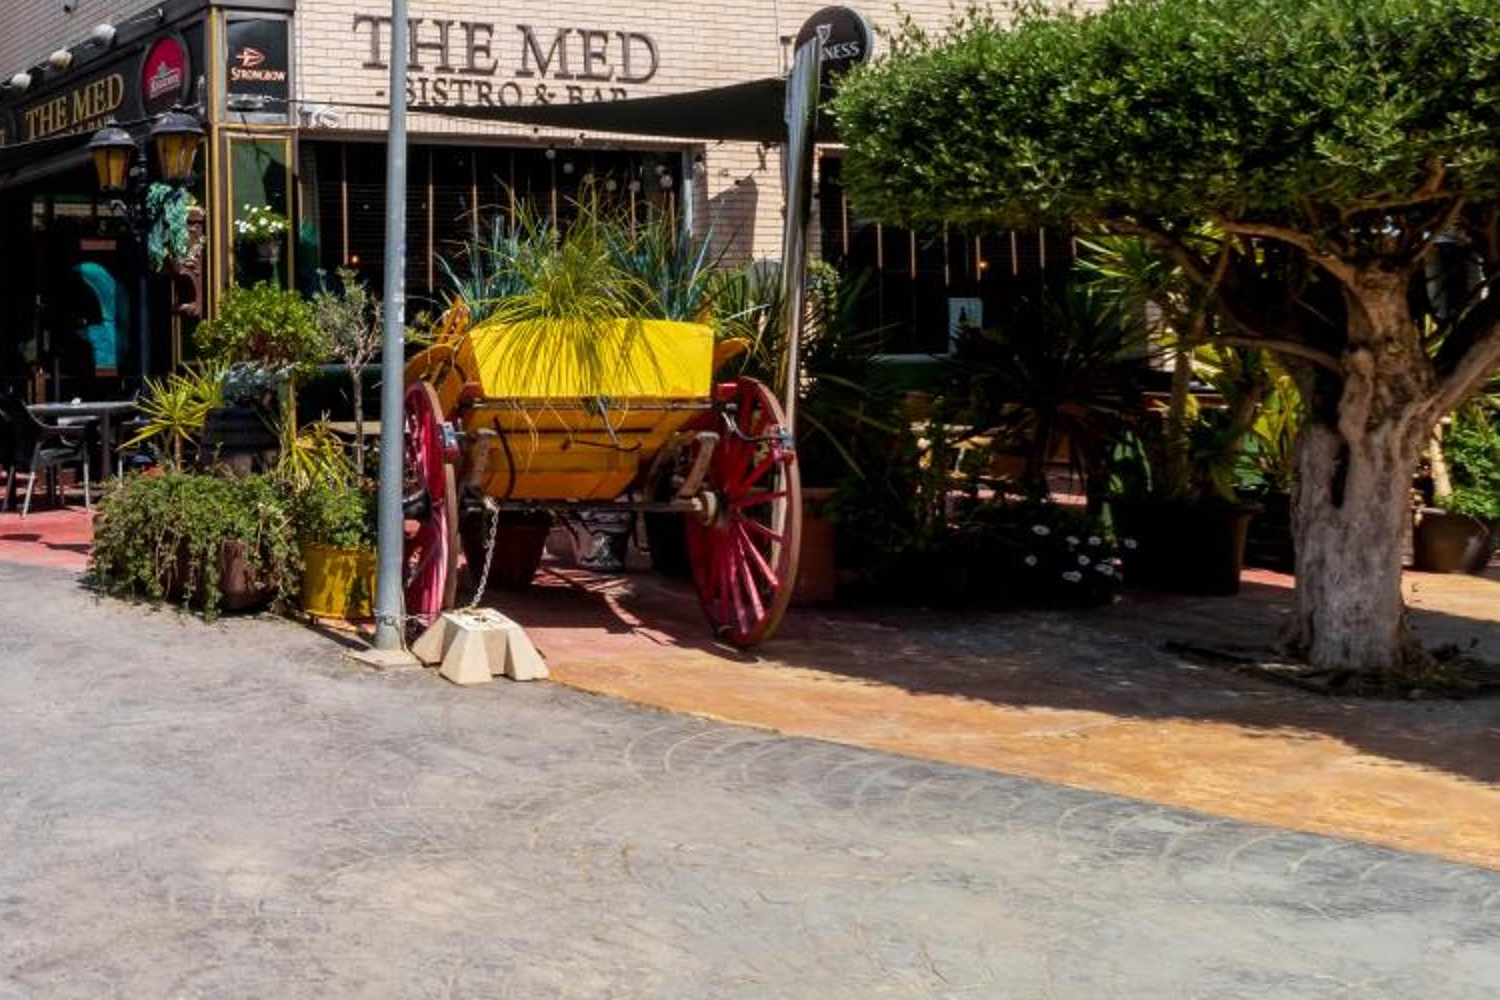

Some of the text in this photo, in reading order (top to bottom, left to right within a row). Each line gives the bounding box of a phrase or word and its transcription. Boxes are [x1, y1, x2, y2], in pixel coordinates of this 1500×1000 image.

[352, 14, 658, 84] THE MED
[26, 73, 125, 141] THE MED
